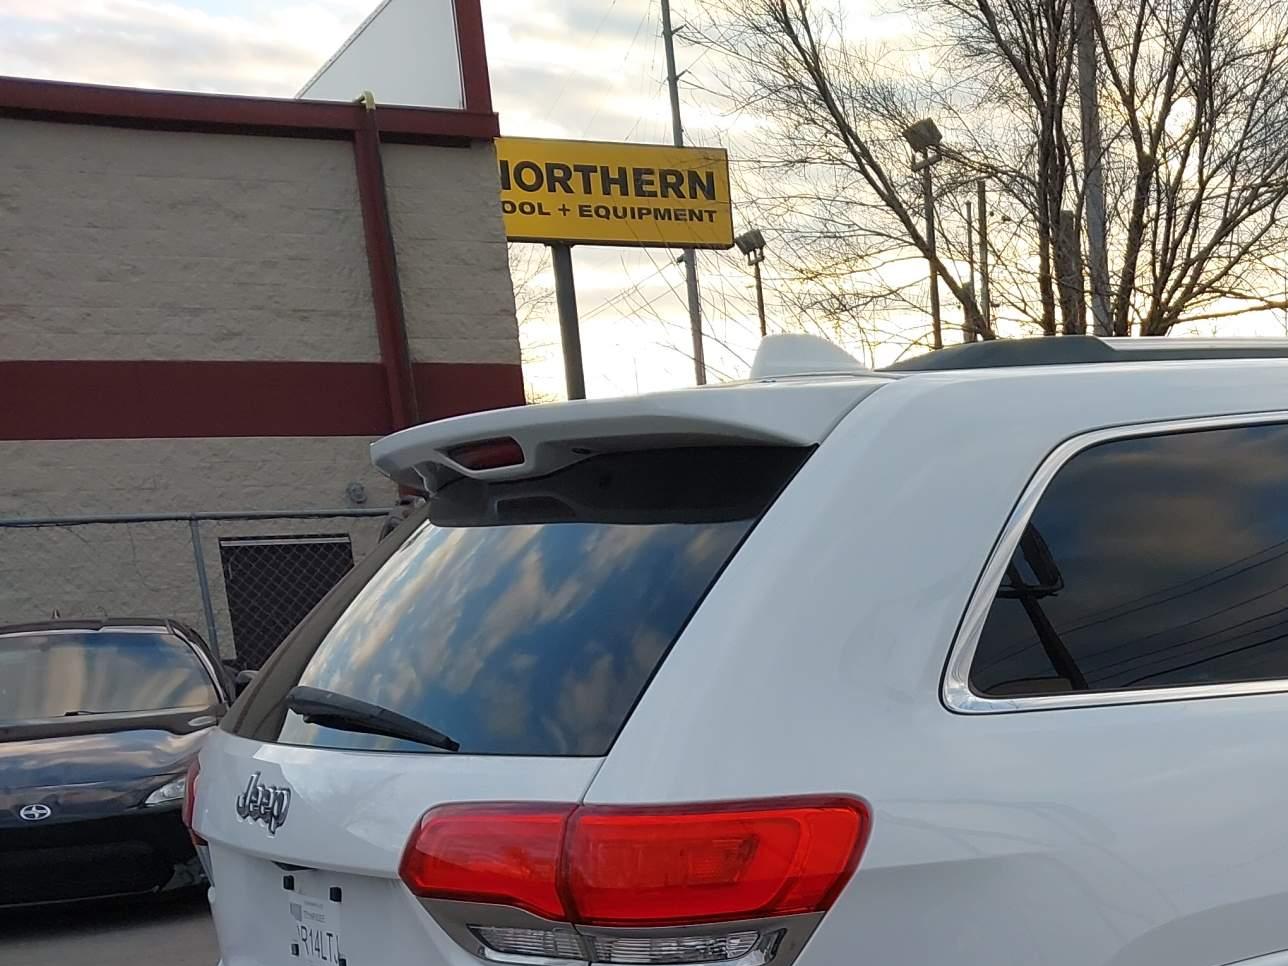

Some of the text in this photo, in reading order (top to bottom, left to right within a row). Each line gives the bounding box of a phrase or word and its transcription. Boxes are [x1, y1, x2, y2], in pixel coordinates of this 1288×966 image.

[558, 204, 571, 217] +
[578, 204, 718, 223] EQUIPMENT
[236, 770, 291, 837] Jeep
